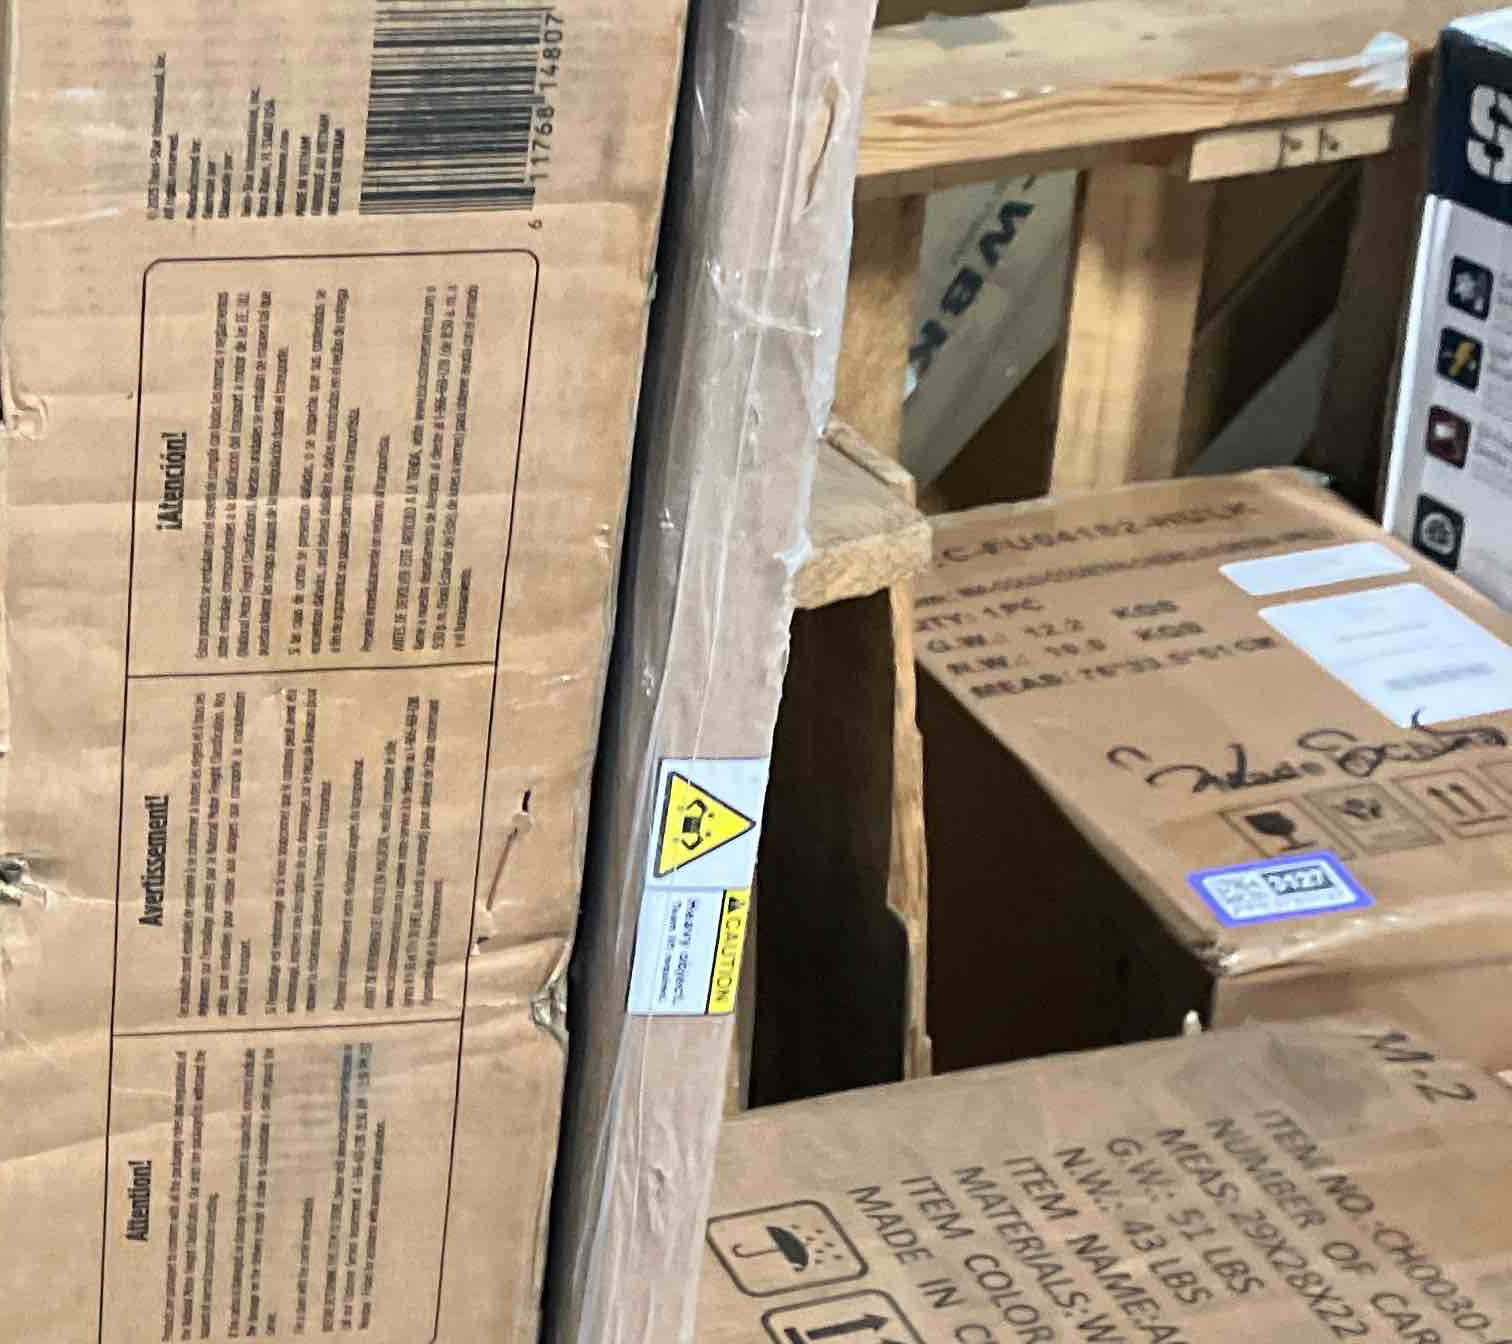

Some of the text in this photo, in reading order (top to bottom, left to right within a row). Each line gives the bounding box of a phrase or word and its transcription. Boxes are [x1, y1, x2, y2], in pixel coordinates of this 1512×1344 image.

[538, 12, 565, 89] 14807
[528, 105, 555, 181] 11768
[527, 217, 544, 231] 6
[137, 794, 170, 927] Avertissement!
[715, 916, 743, 1002] CAUTION
[125, 1160, 153, 1242] Attention!
[900, 1175, 975, 1240] ITEM
[1002, 1155, 1080, 1222] ITEM
[1204, 1116, 1328, 1231] NUMBER
[1321, 1240, 1378, 1276] OF
[845, 1185, 935, 1265] MADE
[916, 1277, 967, 1310] IN
[1121, 1218, 1169, 1253] 43
[1148, 1257, 1215, 1306] LBS
[1166, 1206, 1216, 1243] 51
[1201, 1245, 1266, 1295] LBS
